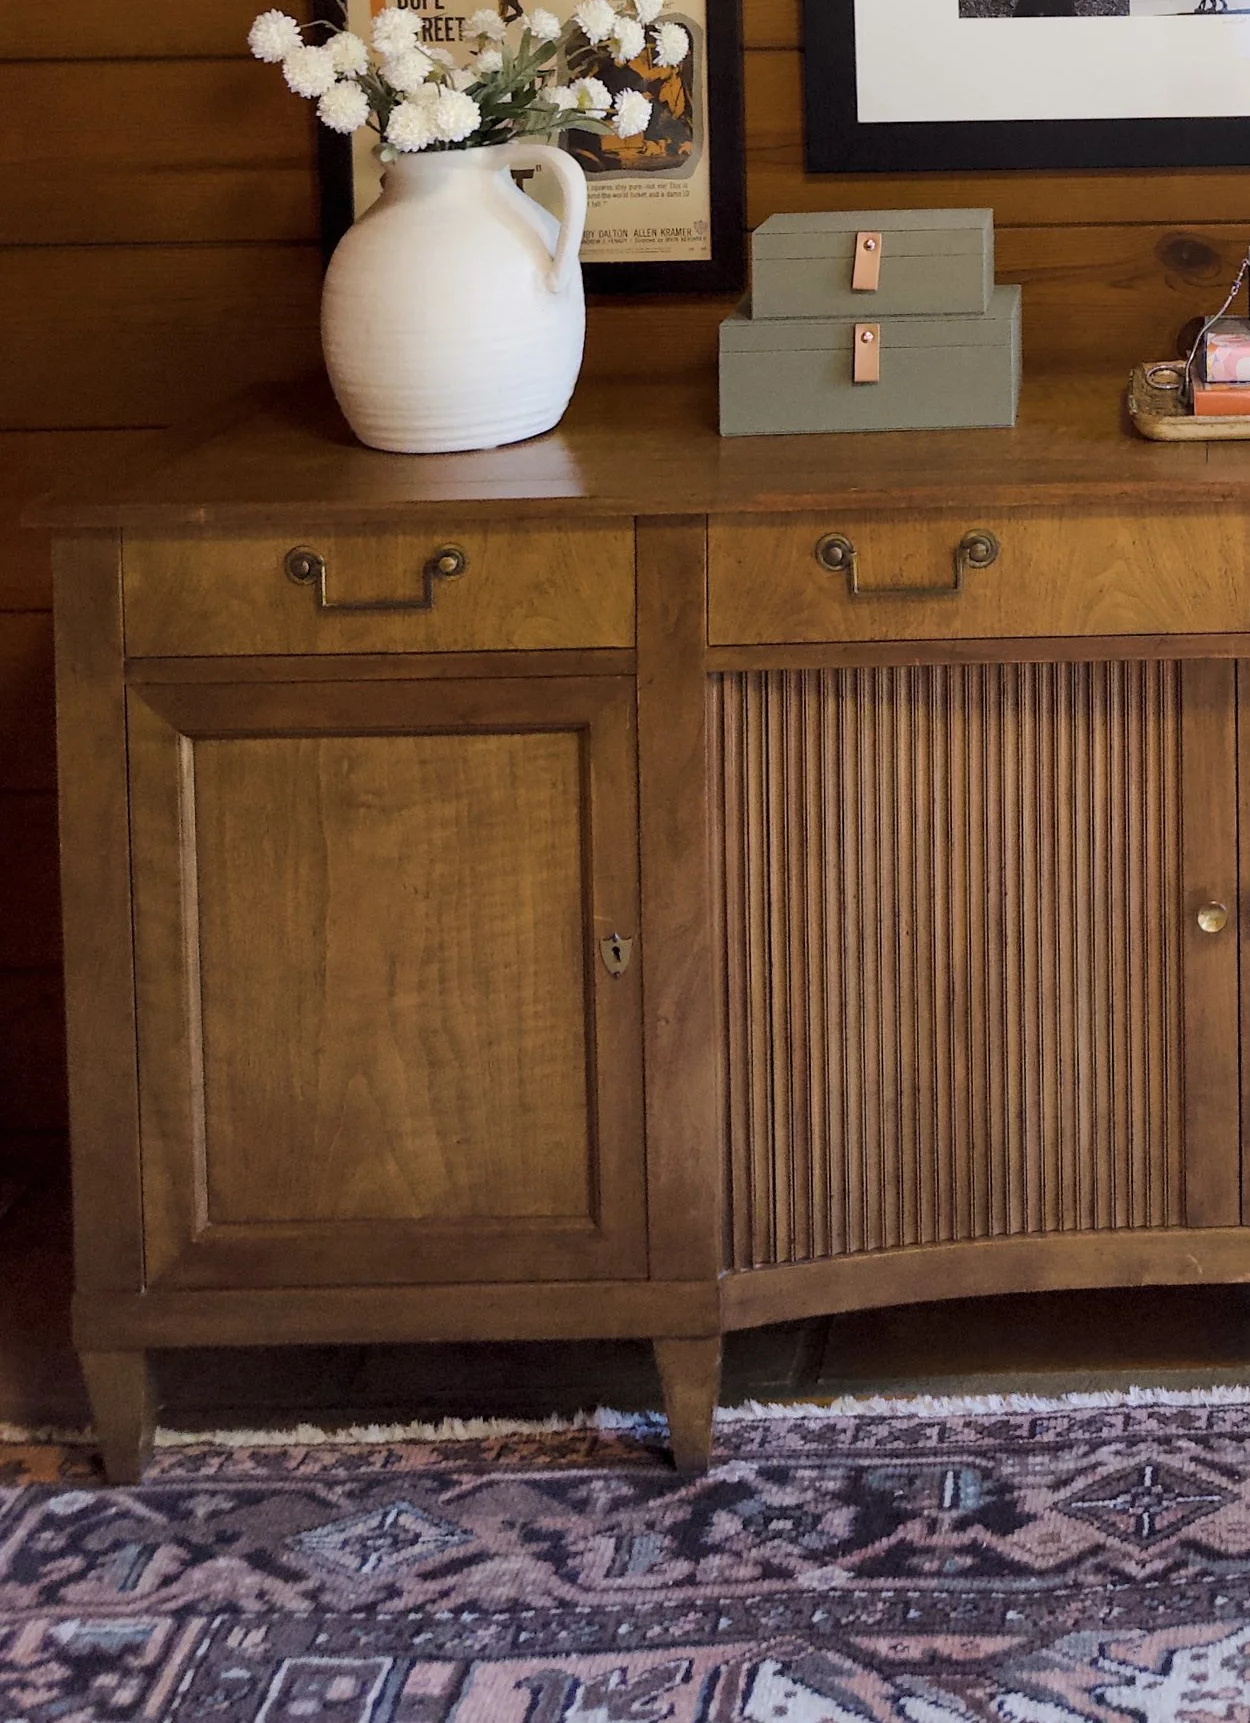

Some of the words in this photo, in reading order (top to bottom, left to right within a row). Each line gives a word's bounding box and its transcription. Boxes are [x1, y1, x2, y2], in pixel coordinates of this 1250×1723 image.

[413, 17, 465, 42] REET
[598, 229, 629, 238] DALTON
[633, 229, 657, 237] ALLEN
[660, 228, 692, 237] KRAMER
